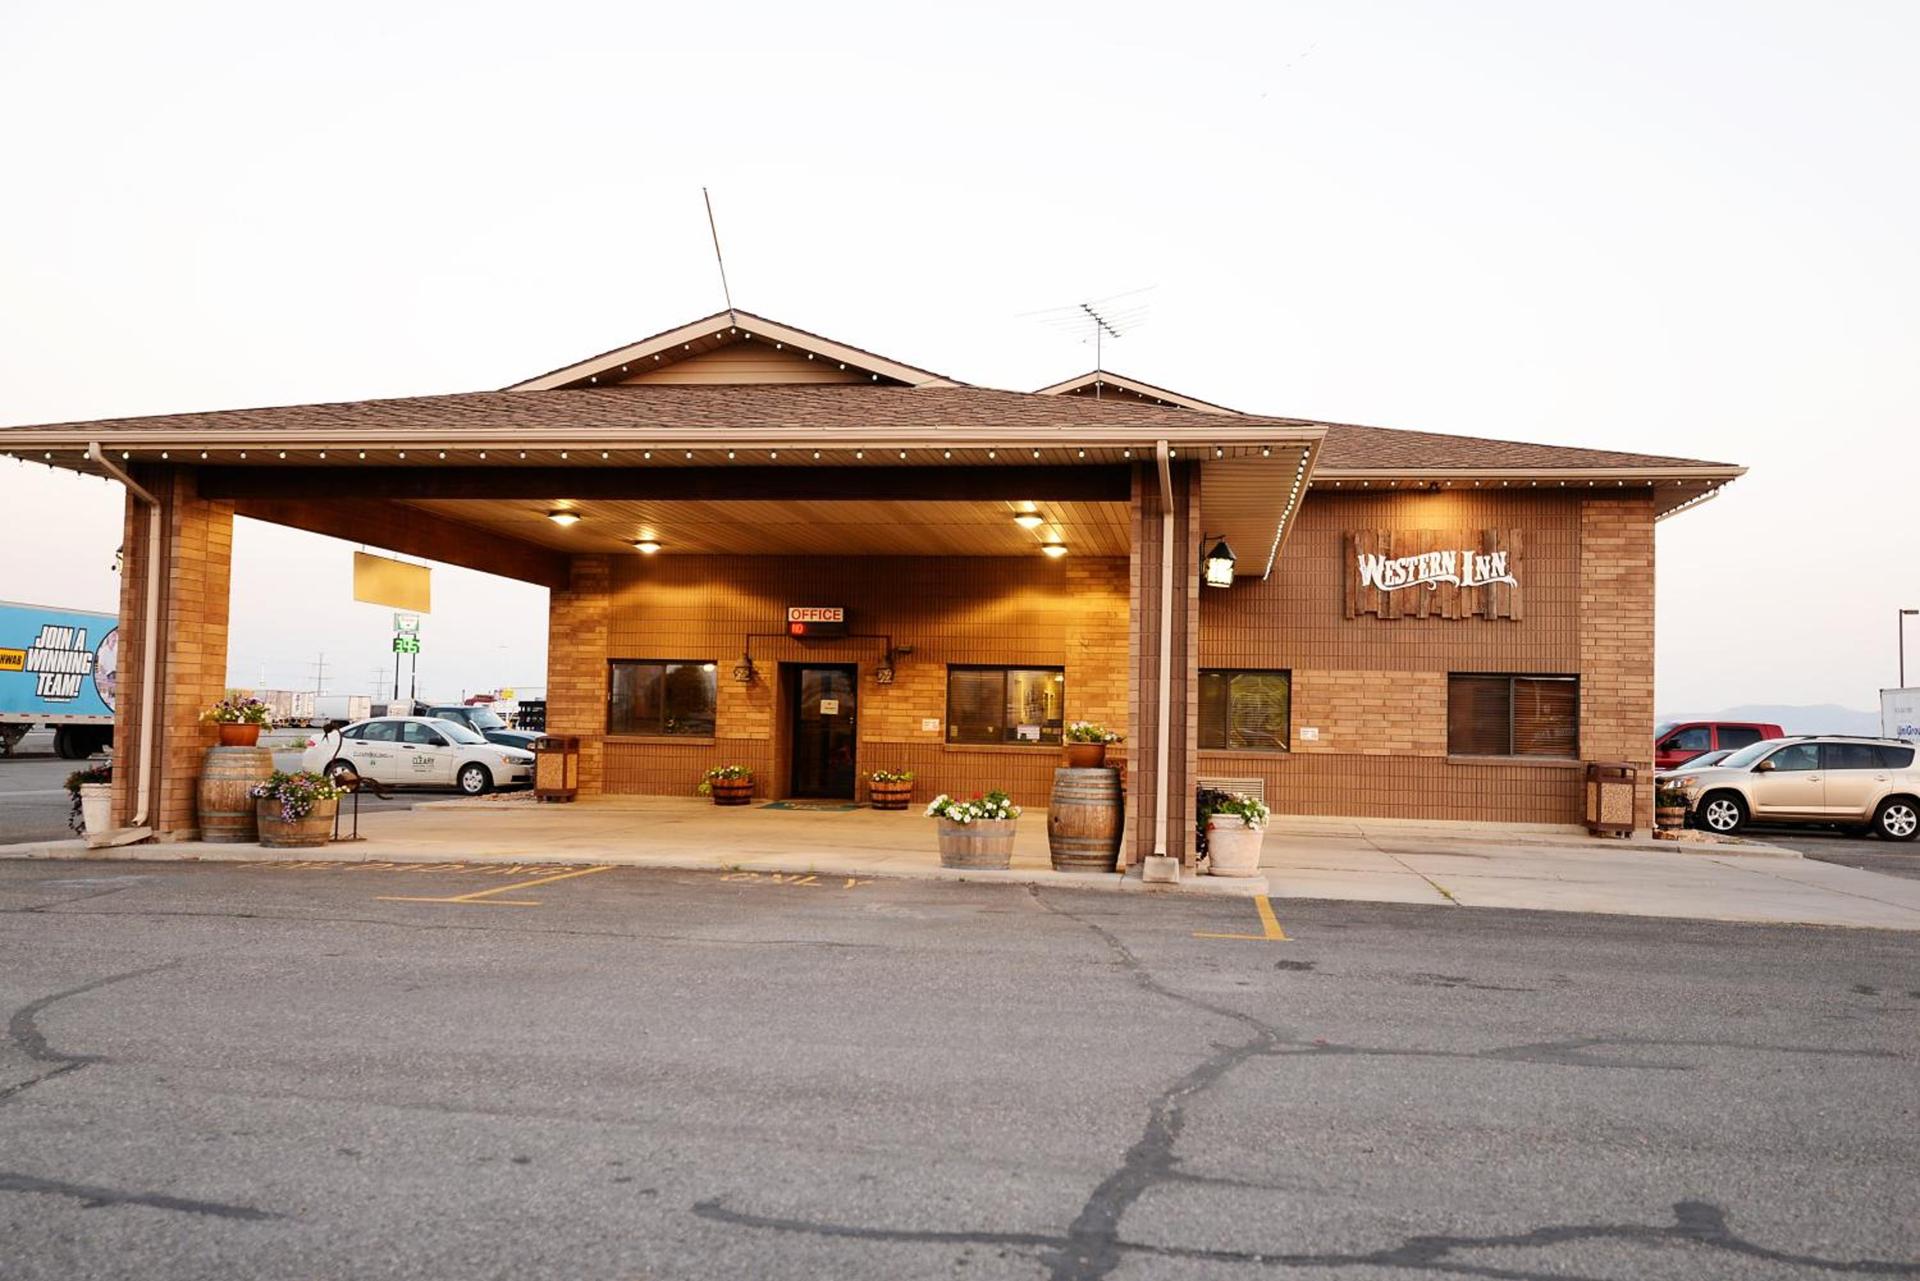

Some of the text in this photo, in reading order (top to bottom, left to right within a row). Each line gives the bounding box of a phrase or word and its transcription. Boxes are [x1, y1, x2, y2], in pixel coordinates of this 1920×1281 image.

[1358, 551, 1517, 591] WESTERN INN
[791, 608, 841, 620] OFFICE
[35, 625, 87, 650] JOIN A
[27, 648, 93, 675] WINNING
[36, 673, 82, 696] TEAM!
